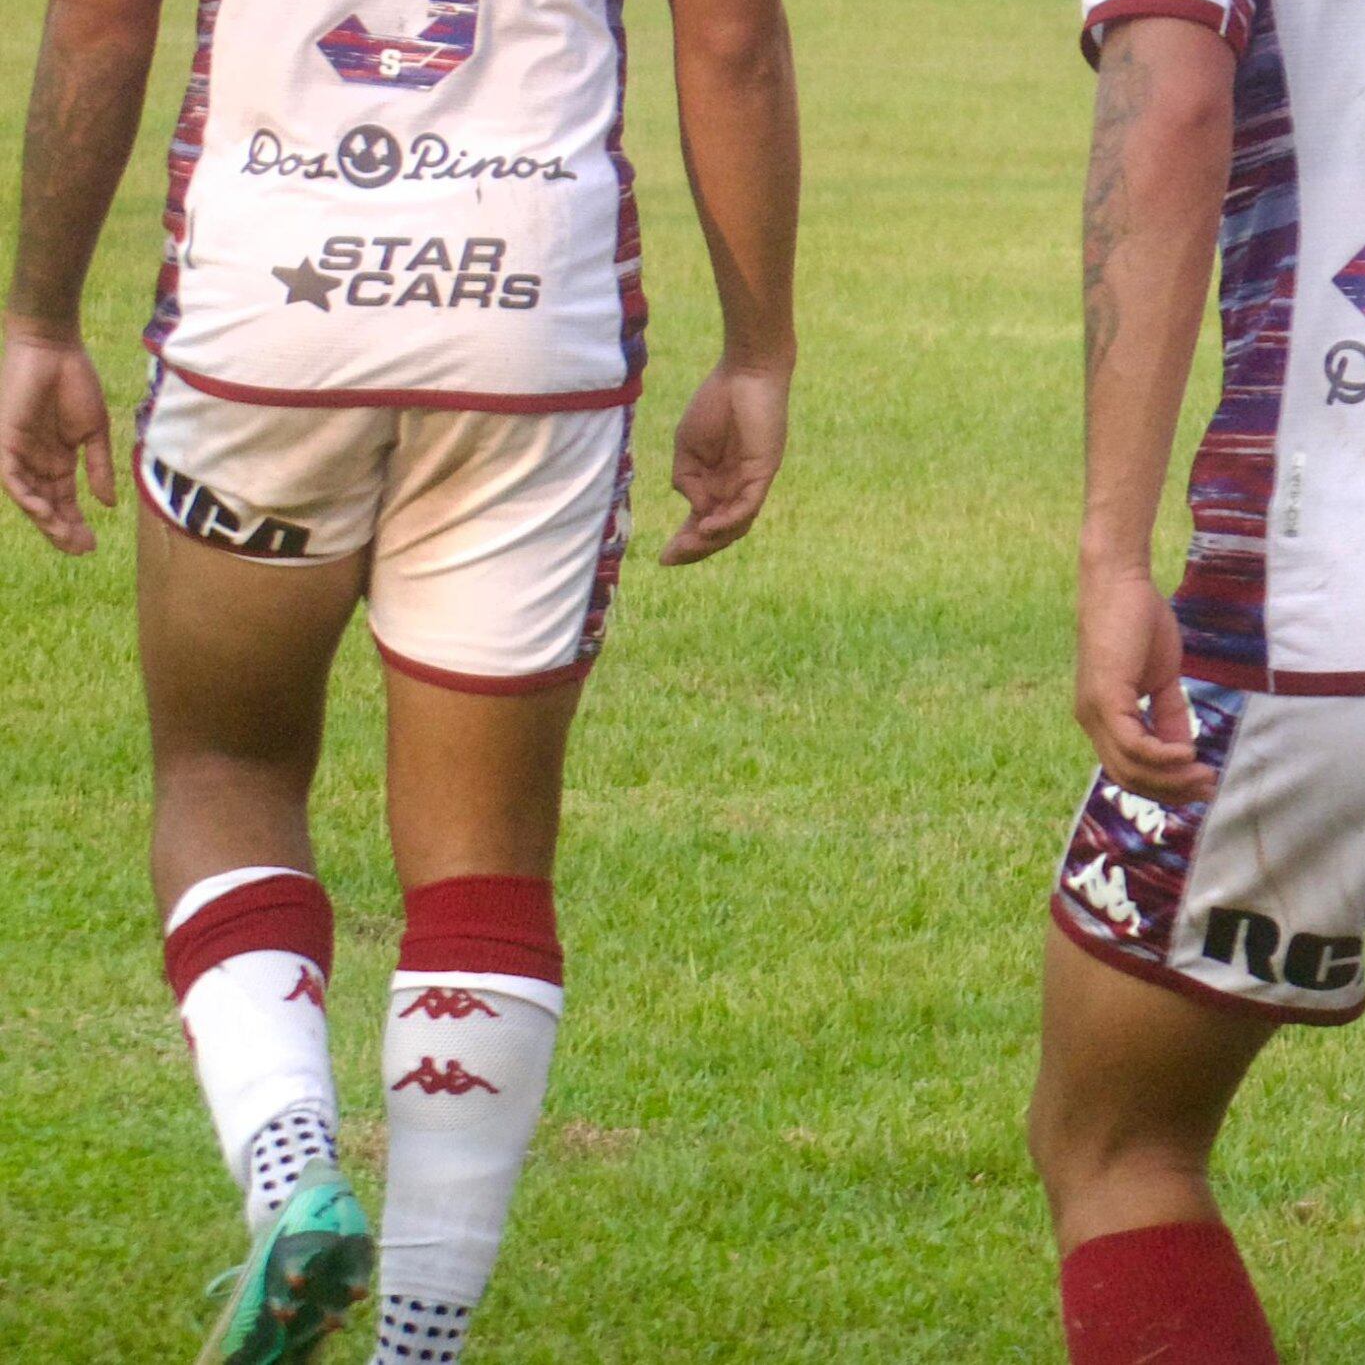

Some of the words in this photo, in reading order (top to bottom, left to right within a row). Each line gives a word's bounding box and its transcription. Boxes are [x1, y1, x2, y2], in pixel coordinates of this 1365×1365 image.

[241, 127, 339, 180] Dos
[402, 131, 578, 182] Pinos
[318, 235, 507, 273] STAR
[345, 270, 542, 310] CARS
[1201, 906, 1364, 992] RC
